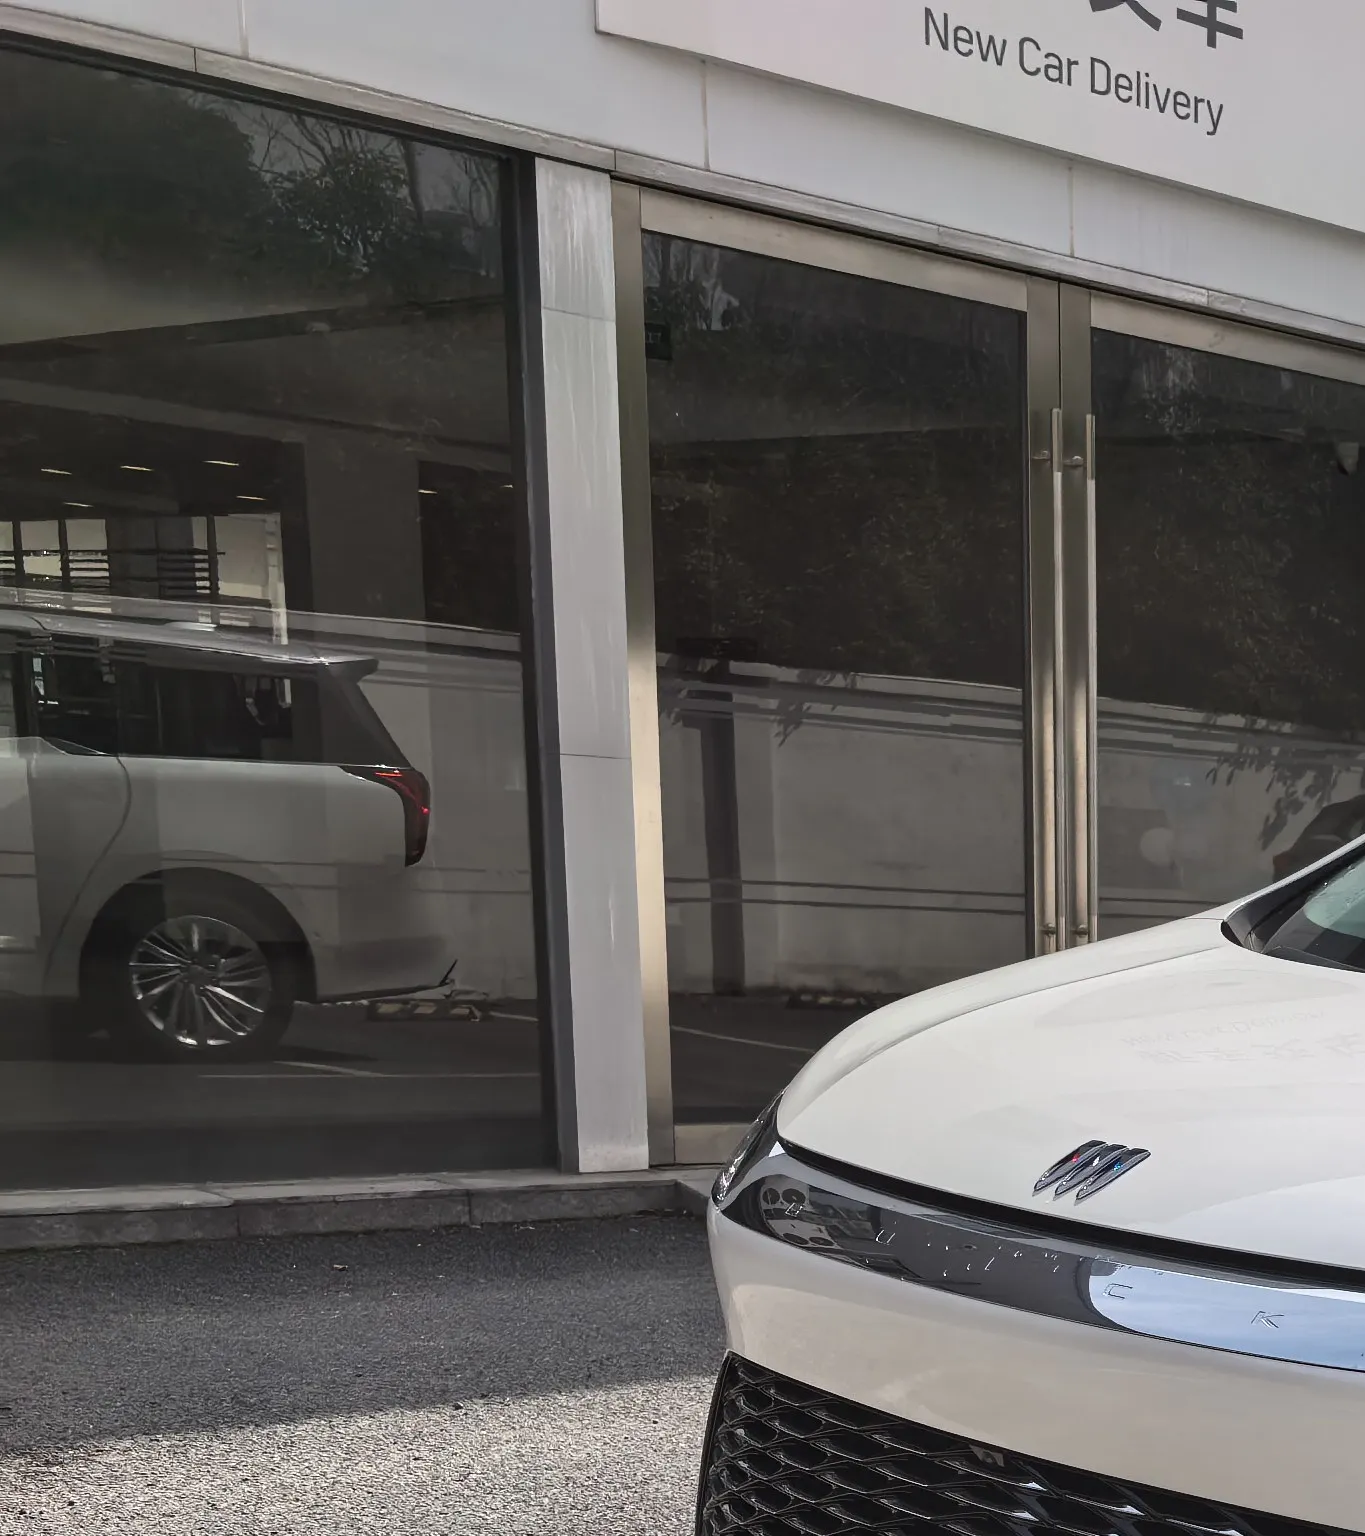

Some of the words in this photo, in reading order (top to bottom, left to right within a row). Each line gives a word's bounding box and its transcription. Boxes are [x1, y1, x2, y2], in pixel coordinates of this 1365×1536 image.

[924, 6, 1008, 67] New
[1018, 36, 1079, 87] Car
[1090, 56, 1224, 136] Delivery
